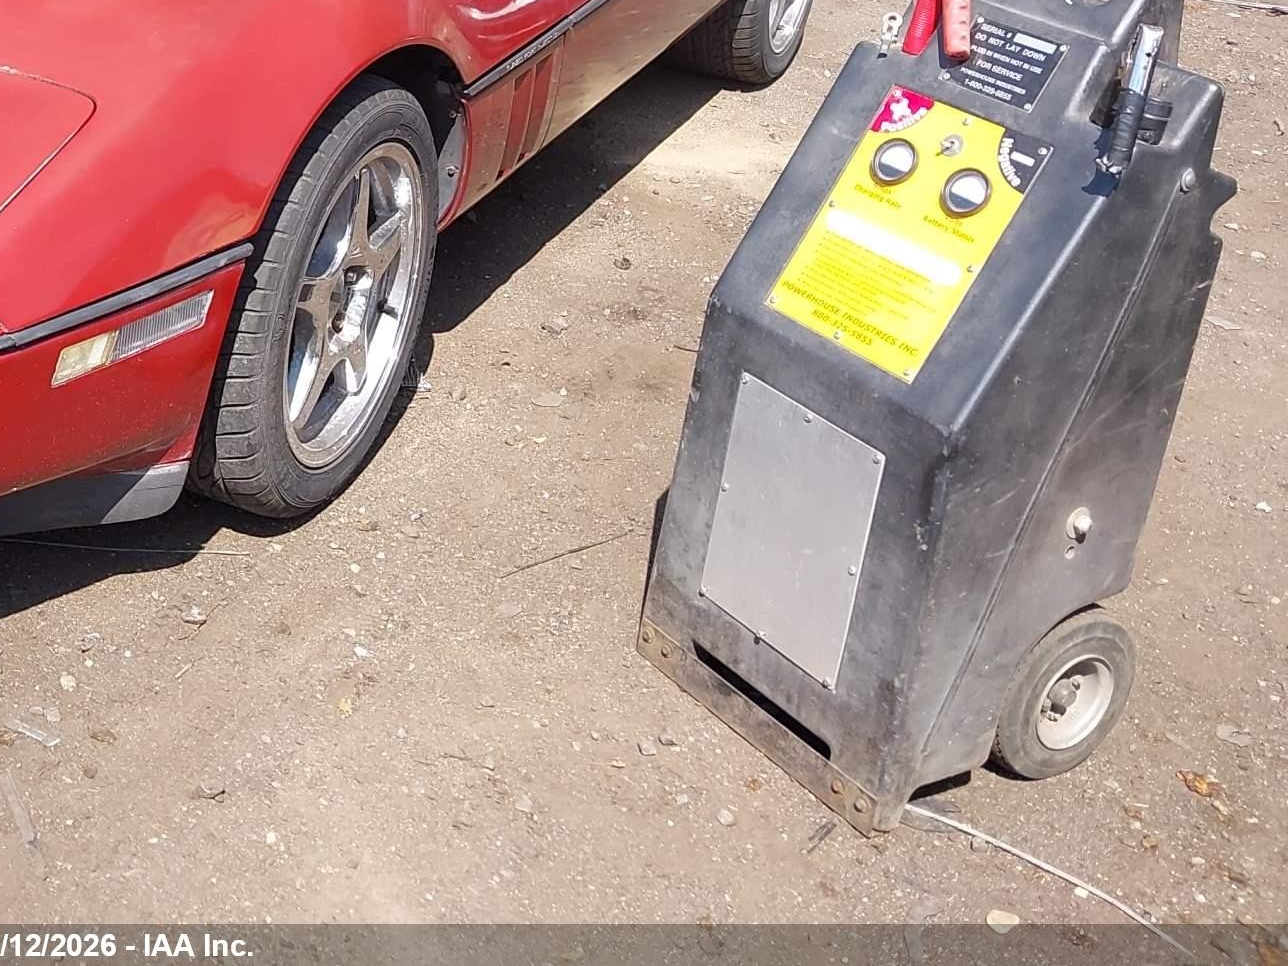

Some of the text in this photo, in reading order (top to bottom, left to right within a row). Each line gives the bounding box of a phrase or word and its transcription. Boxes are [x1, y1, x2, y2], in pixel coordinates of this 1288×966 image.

[981, 23, 1006, 37] SERIAL
[975, 32, 1047, 62] DO NOT LAY DOWN
[976, 59, 1024, 81] FOR SERVICE
[922, 214, 976, 244] Battery Status
[782, 279, 841, 316] POWERHOUSE
[841, 311, 898, 347] INDUSTRIES
